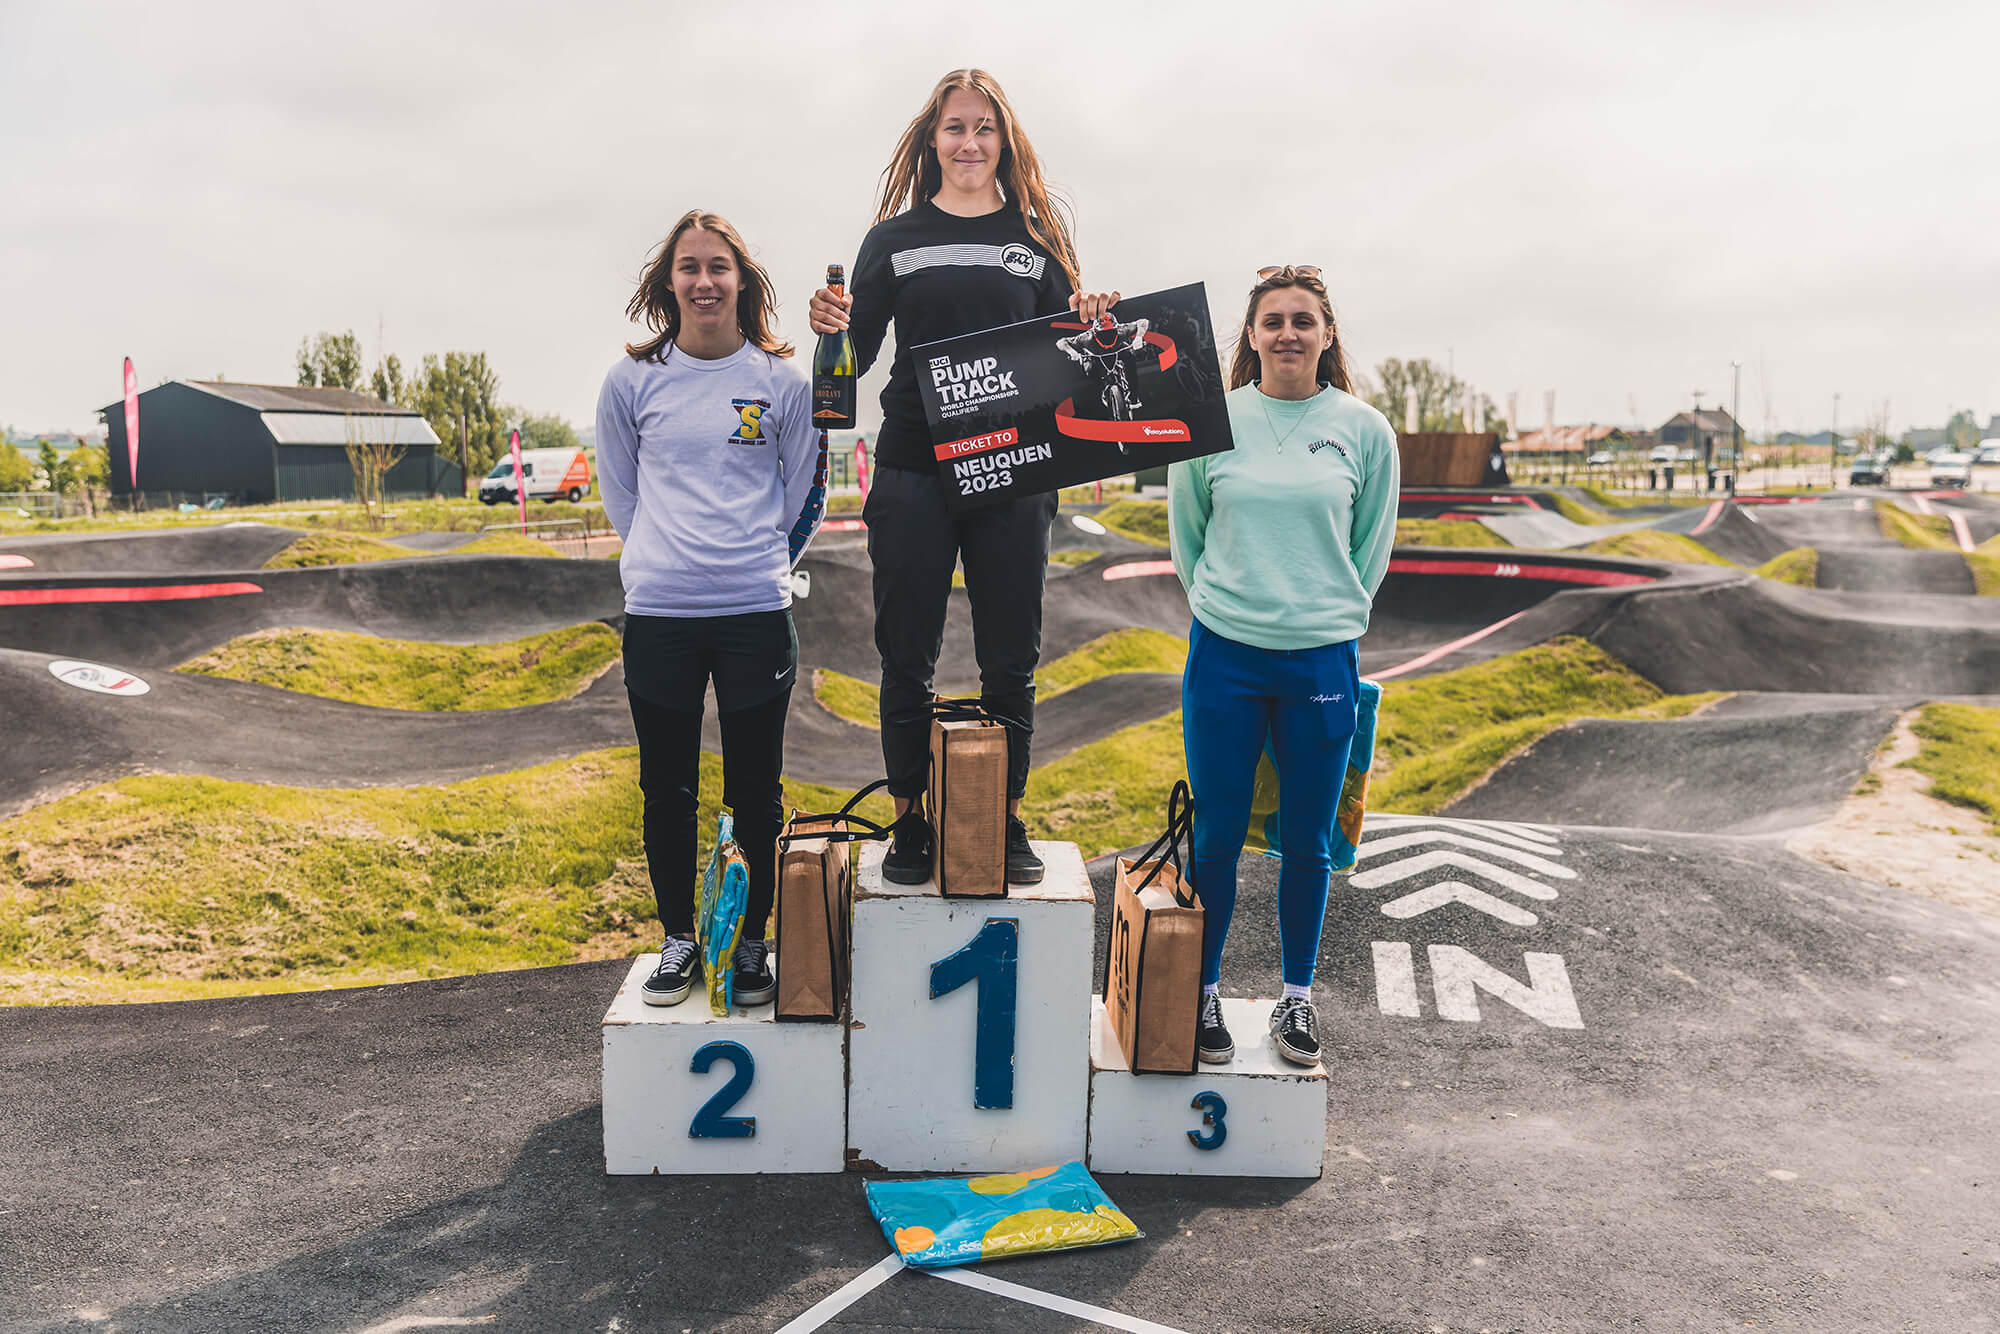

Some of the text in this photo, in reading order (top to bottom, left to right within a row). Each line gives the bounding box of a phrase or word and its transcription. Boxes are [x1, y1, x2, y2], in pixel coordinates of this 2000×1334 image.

[931, 357, 997, 387] PUMP
[933, 356, 950, 367] UCI
[936, 371, 1017, 404] TRACK
[940, 389, 1020, 412] WORLD CHAMPIONSHIPS
[740, 405, 761, 439] S
[941, 405, 979, 418] QUALIFIERS
[949, 432, 1012, 454] TICKET TO
[953, 443, 1053, 479] NEUQUEN
[959, 470, 1013, 495] 2023
[1371, 941, 1585, 1029] IN
[928, 917, 1019, 1110] 1
[688, 1039, 756, 1138] 2
[1186, 1090, 1227, 1150] 3
